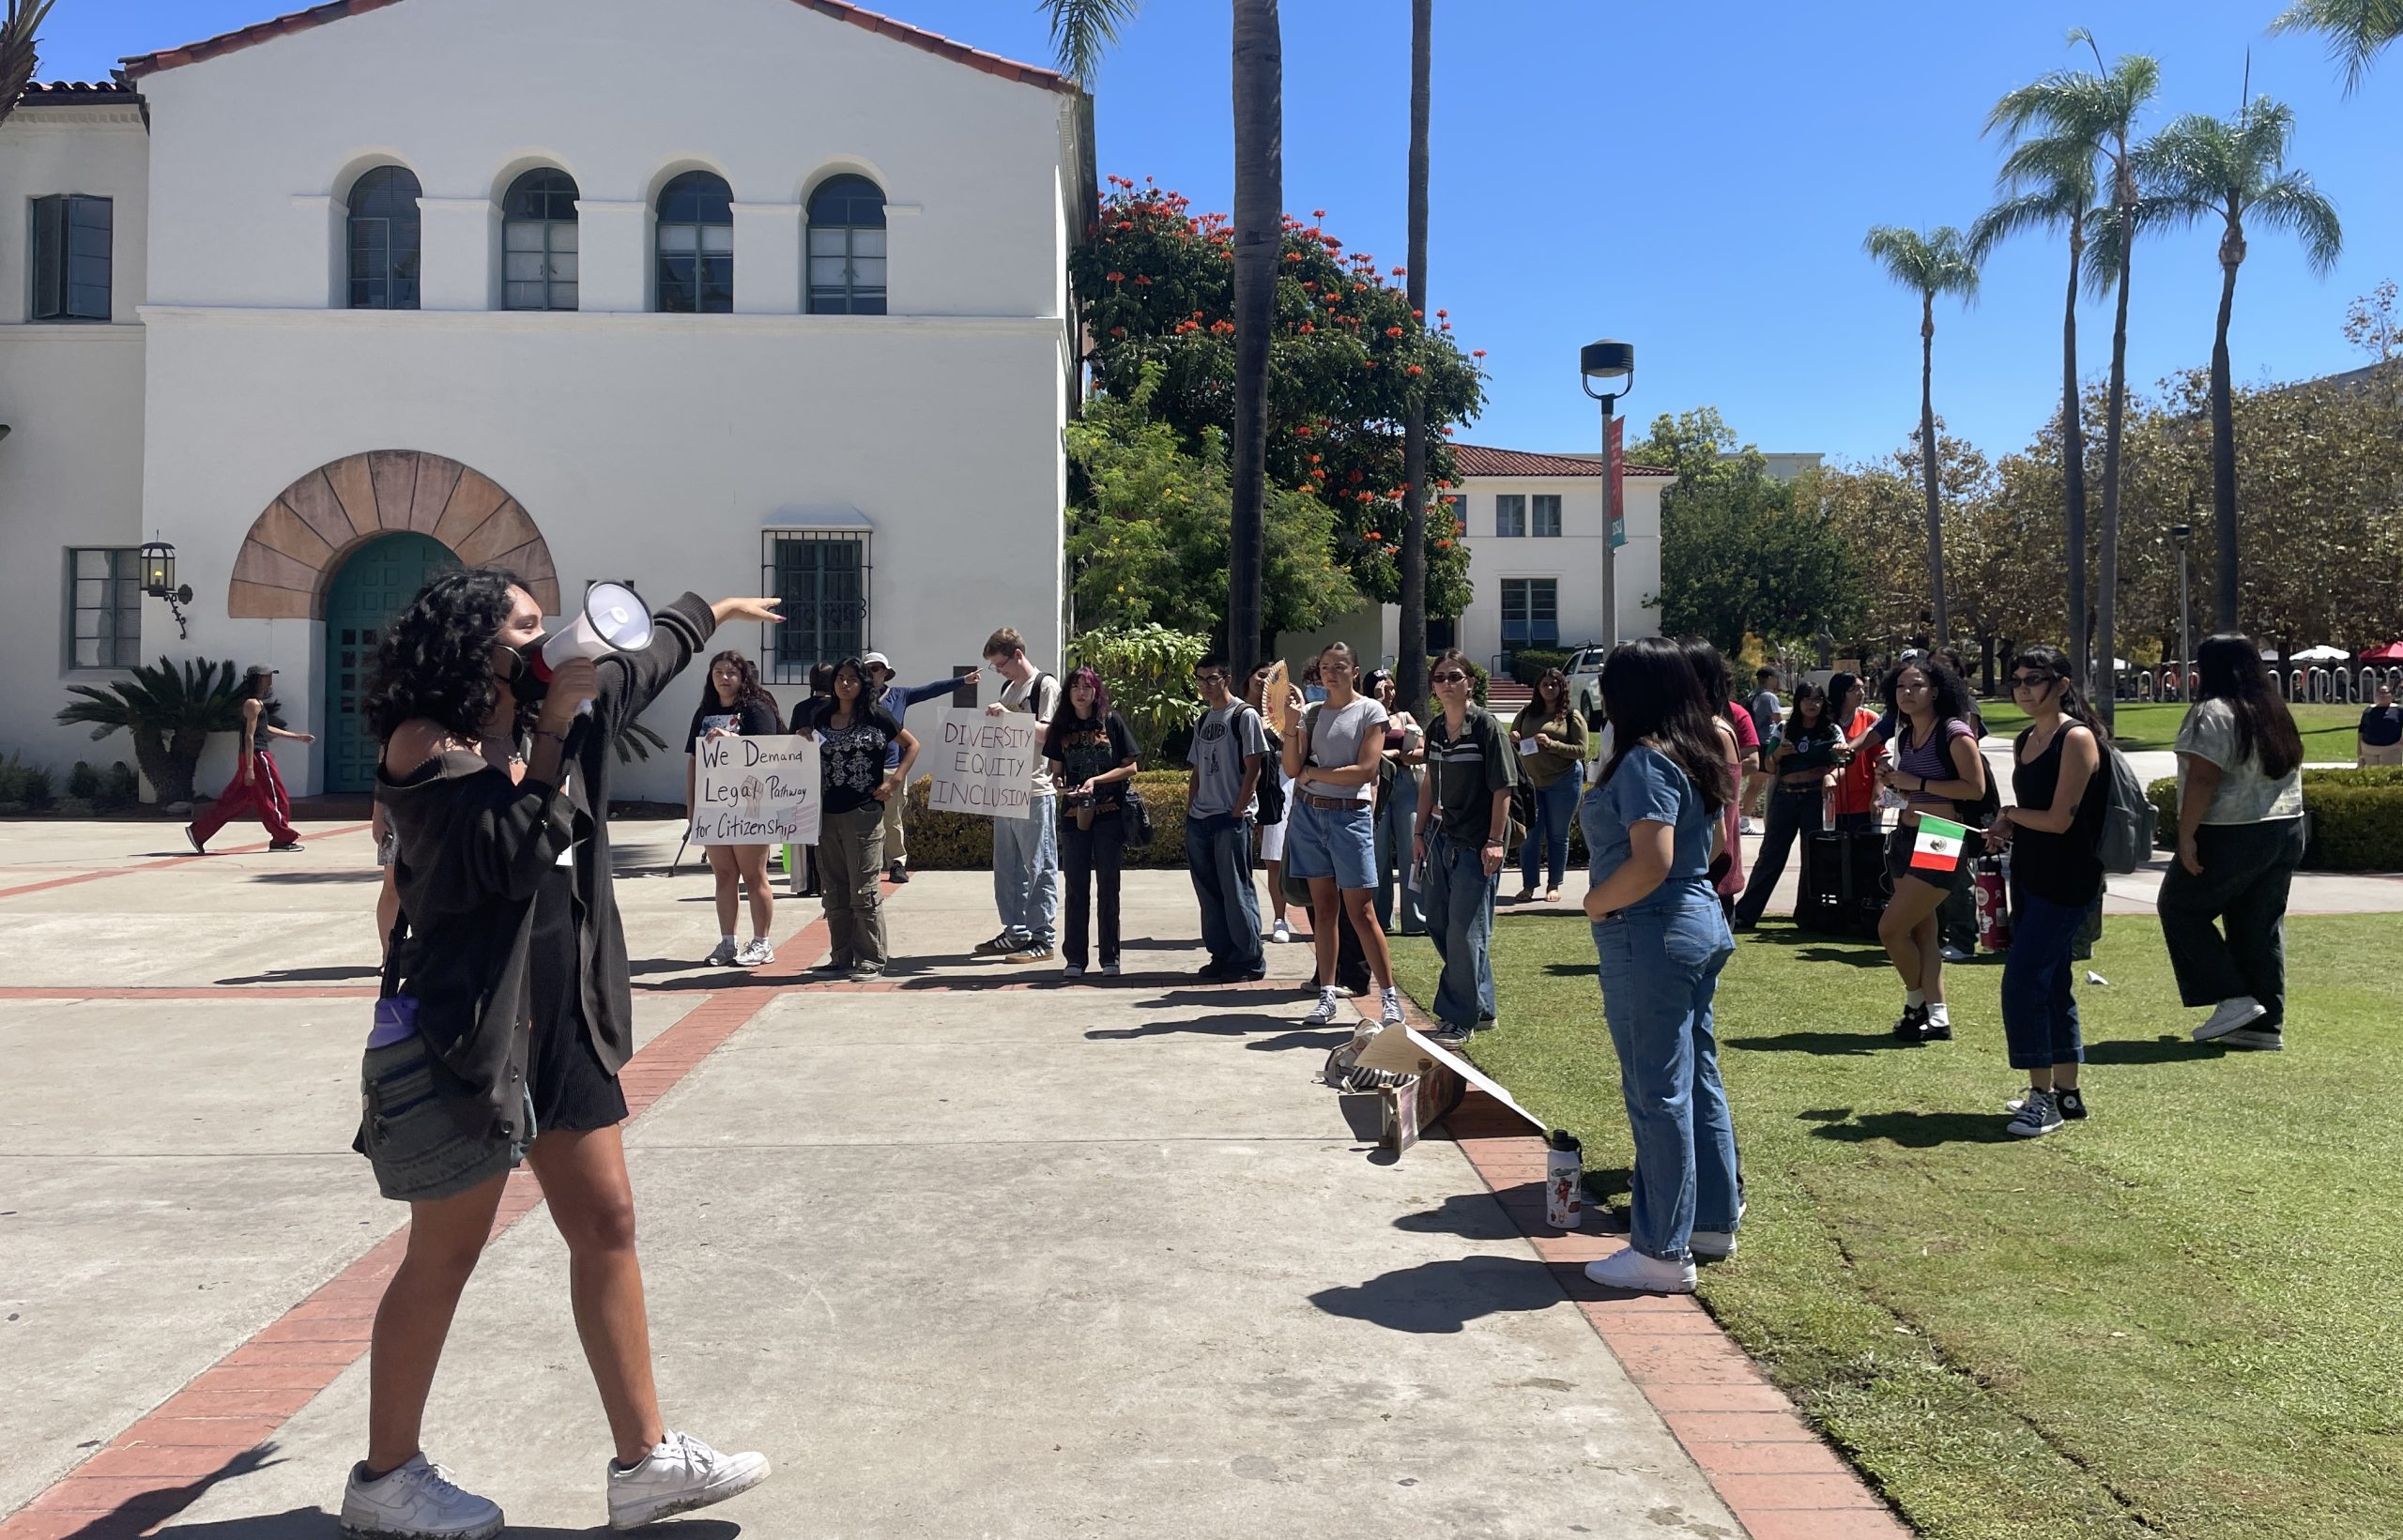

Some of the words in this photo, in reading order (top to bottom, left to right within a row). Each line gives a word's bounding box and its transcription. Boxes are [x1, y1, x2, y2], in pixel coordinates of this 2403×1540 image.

[944, 722, 1033, 748] DIVERSITY
[701, 740, 728, 768] We
[742, 740, 803, 767] Demand
[955, 751, 1025, 777] EQUITY
[705, 777, 758, 807] Legal
[765, 775, 806, 804] Pathway
[932, 780, 1032, 807] INCLUSION
[695, 816, 712, 839] for
[717, 813, 798, 841] Citizenship
